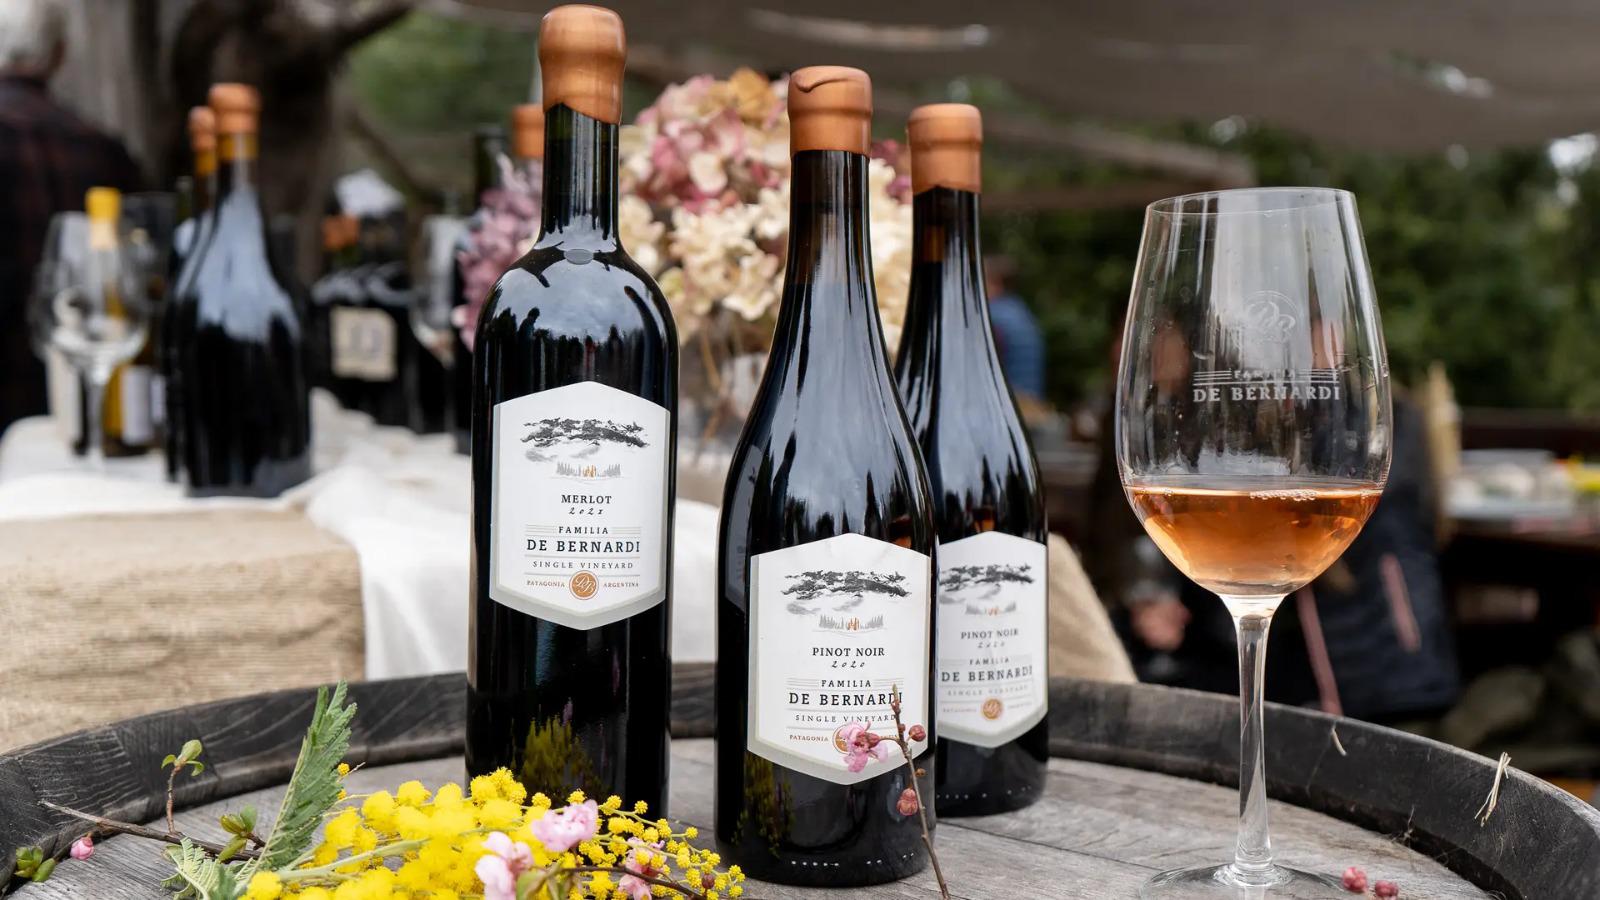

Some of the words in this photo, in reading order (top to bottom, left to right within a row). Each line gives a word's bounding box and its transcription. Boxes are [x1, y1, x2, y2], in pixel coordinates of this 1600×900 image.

[1193, 388, 1221, 402] DE
[1231, 386, 1340, 401] BERNARDI
[561, 494, 612, 504] MERLOT
[568, 506, 604, 516] 2021
[558, 526, 609, 535] FAMILIA
[527, 539, 548, 551] DE
[556, 540, 640, 553] BERNARDI
[532, 560, 574, 569] SINGLE
[526, 580, 566, 588] PATAGONIA
[961, 630, 993, 640] PINOT
[996, 628, 1018, 637] NOIR
[812, 647, 852, 657] PINOT
[856, 647, 886, 657] NOIR
[831, 660, 866, 669] 2020
[969, 657, 1010, 666] FAMILIA
[941, 671, 961, 683] DE
[968, 665, 1033, 682] BERNARDI
[821, 679, 872, 688] FAMILIA
[789, 692, 811, 705] DE
[795, 714, 837, 723] SINGLE
[843, 714, 897, 723] VINEYARD
[789, 734, 829, 742] PATAGONIA
